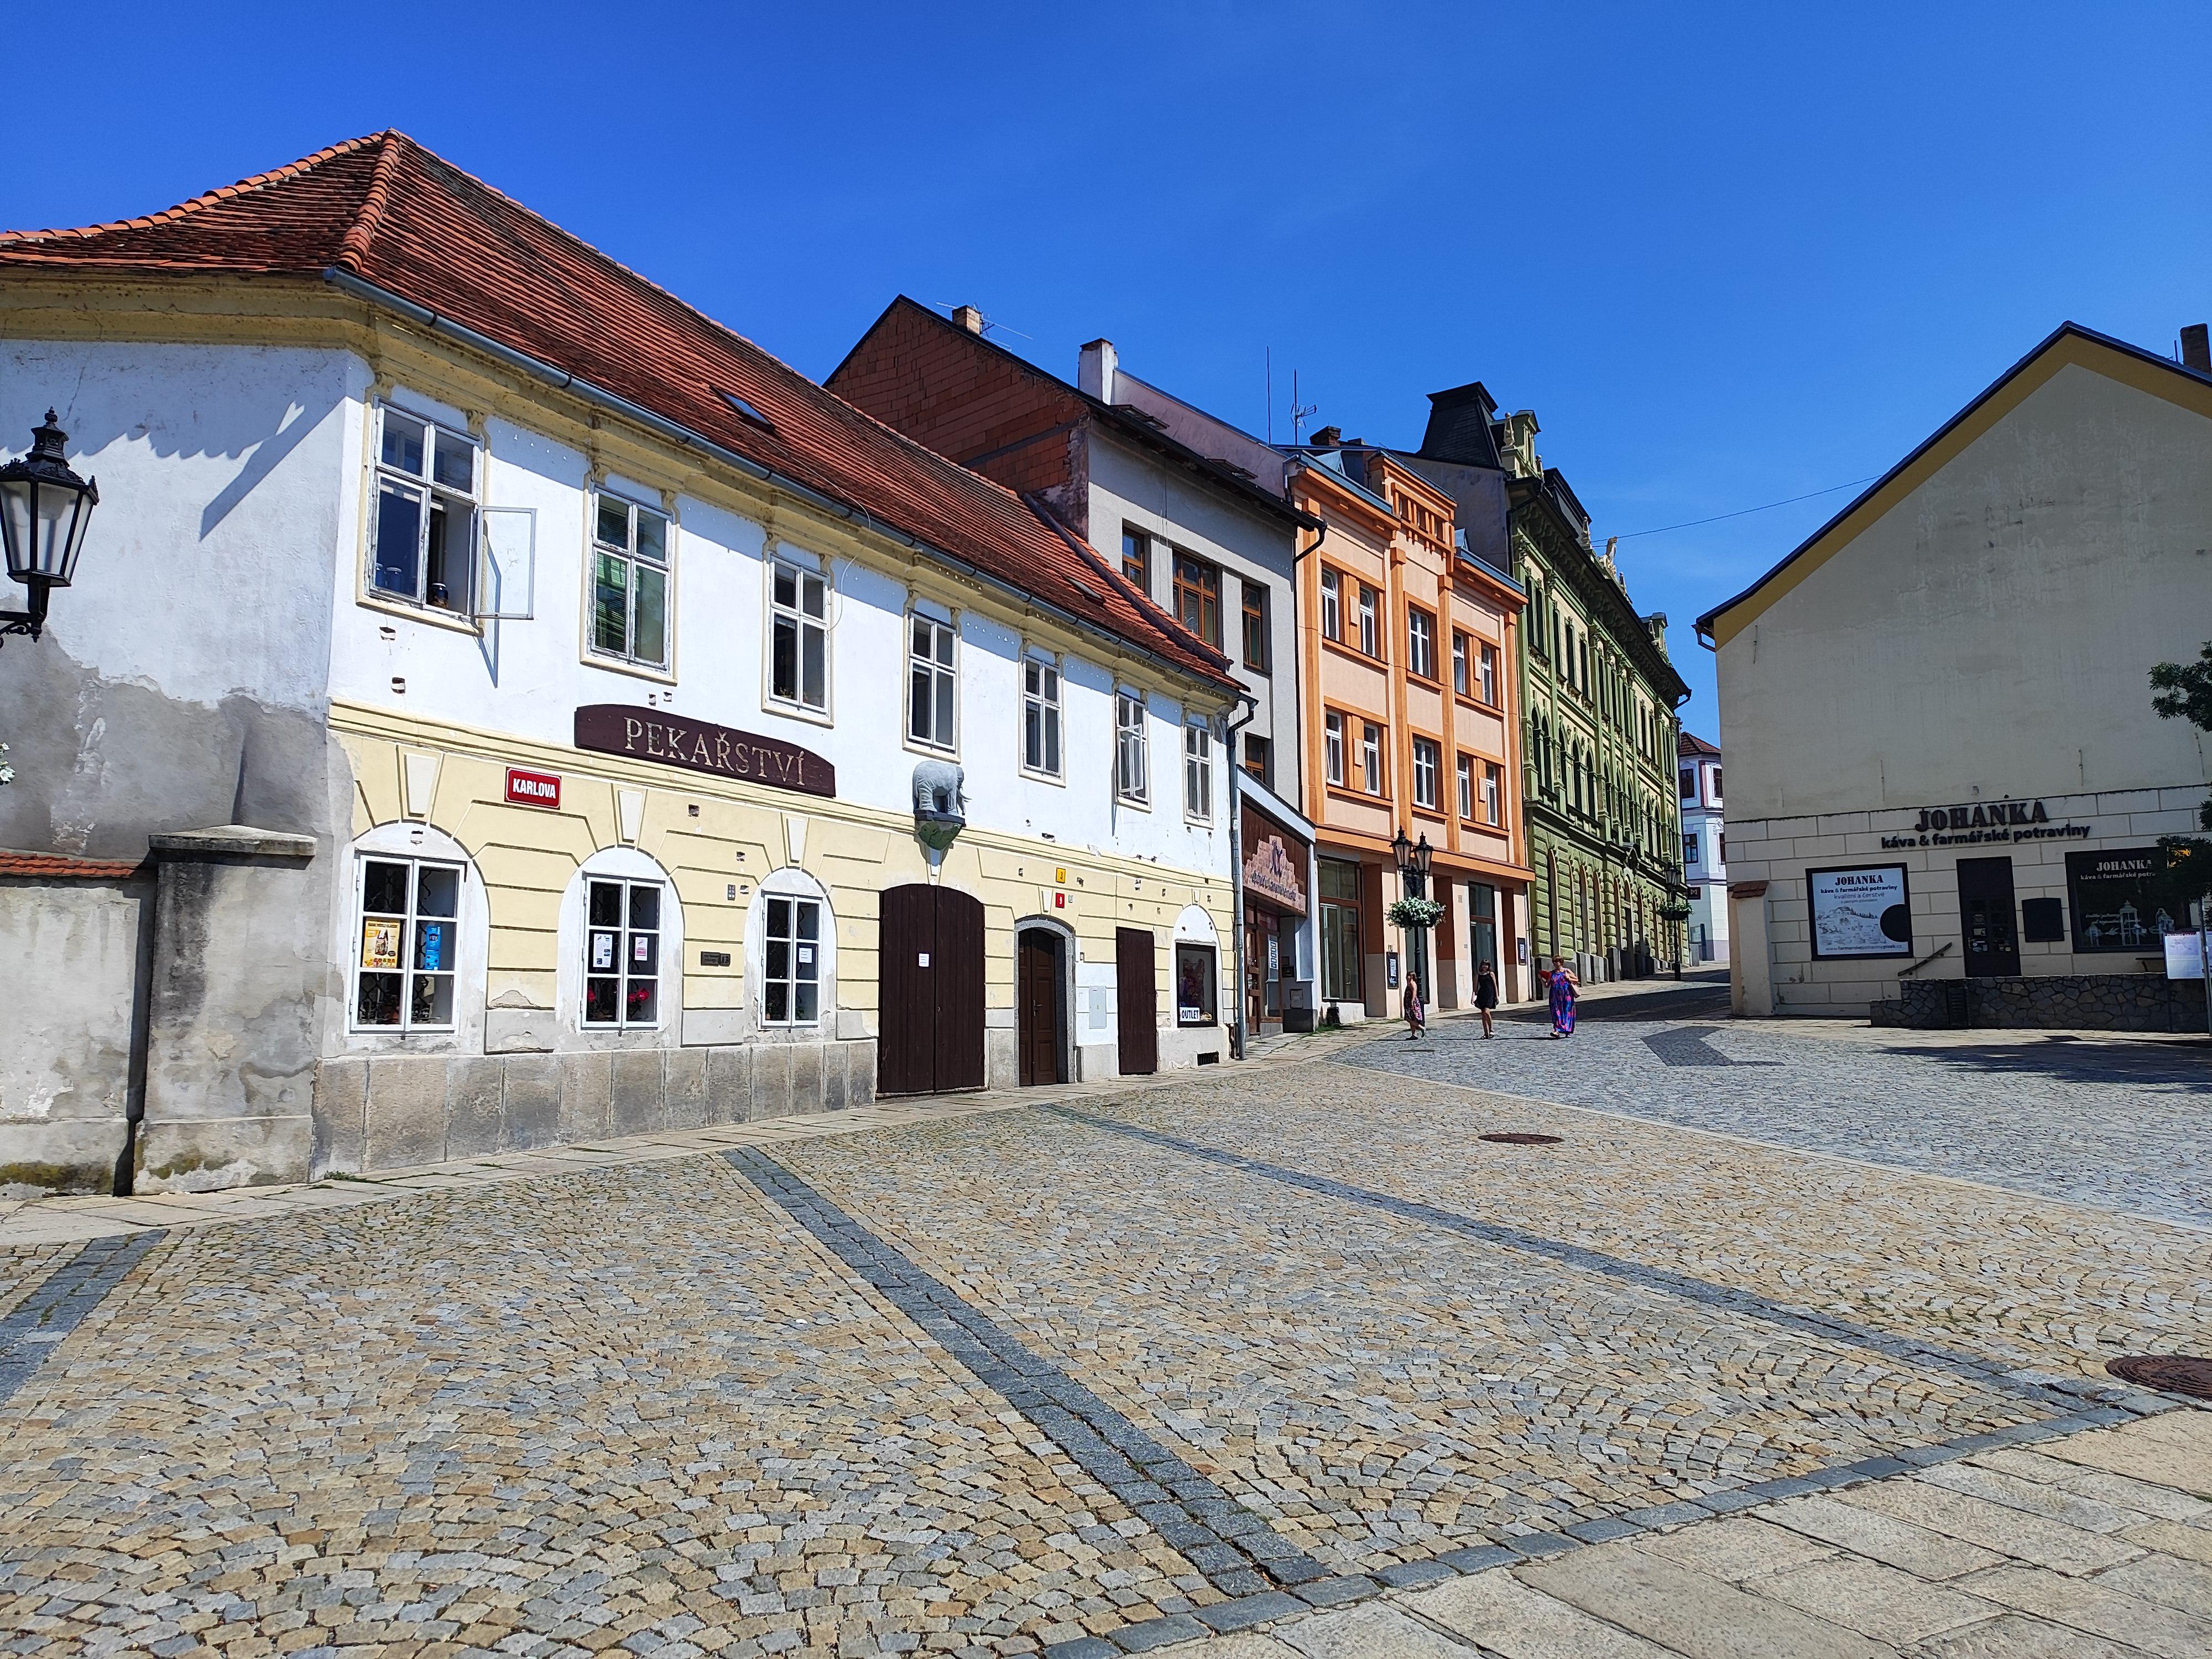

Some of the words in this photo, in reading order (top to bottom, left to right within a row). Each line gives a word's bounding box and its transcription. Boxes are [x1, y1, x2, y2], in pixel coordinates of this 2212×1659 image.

[624, 717, 805, 786] PEKAŘSTVÍ
[513, 778, 556, 799] KARLOVA
[1914, 801, 2049, 832] JOHANKA
[1881, 836, 1916, 848] káva
[1918, 835, 1929, 846] &
[1932, 828, 2010, 846] farmářské
[2013, 823, 2091, 843] potraviny
[1835, 875, 1884, 885] JOHANKA
[1059, 896, 1062, 905] 9
[1181, 1010, 1199, 1019] OUTLET
